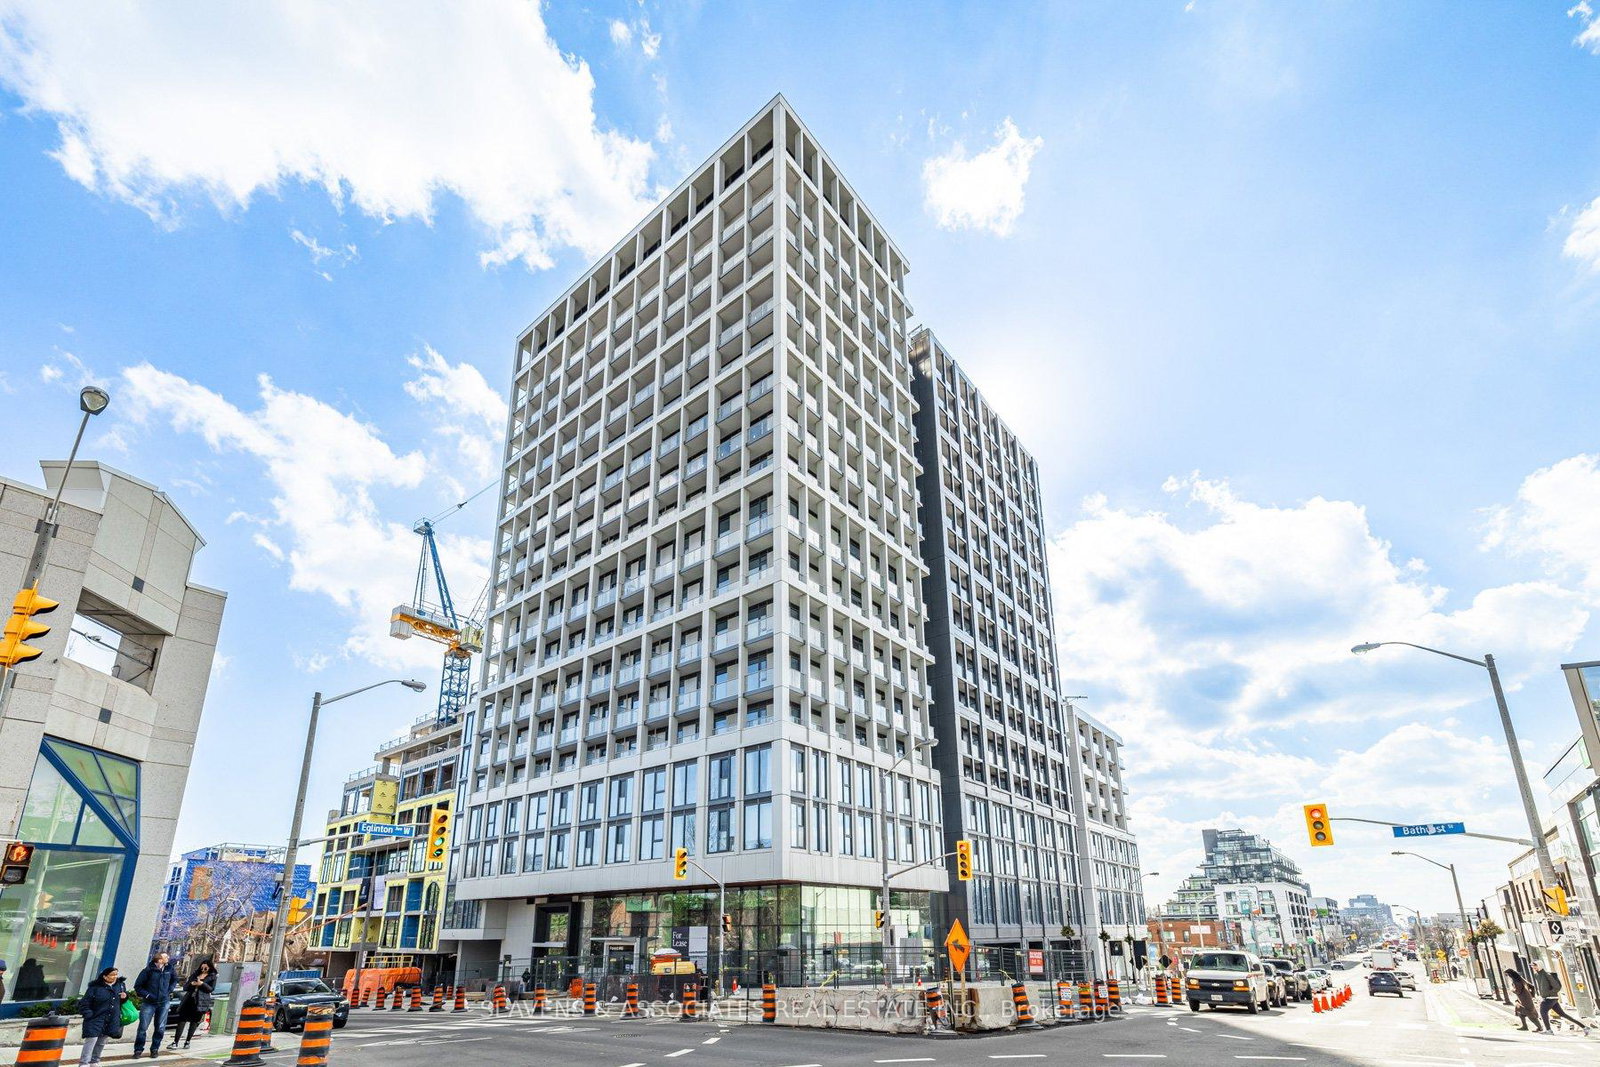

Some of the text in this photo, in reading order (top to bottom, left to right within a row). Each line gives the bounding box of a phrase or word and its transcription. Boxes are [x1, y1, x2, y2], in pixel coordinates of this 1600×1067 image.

[361, 823, 393, 834] Eglinton
[403, 826, 411, 835] W
[672, 931, 683, 940] For
[672, 939, 688, 947] Lease
